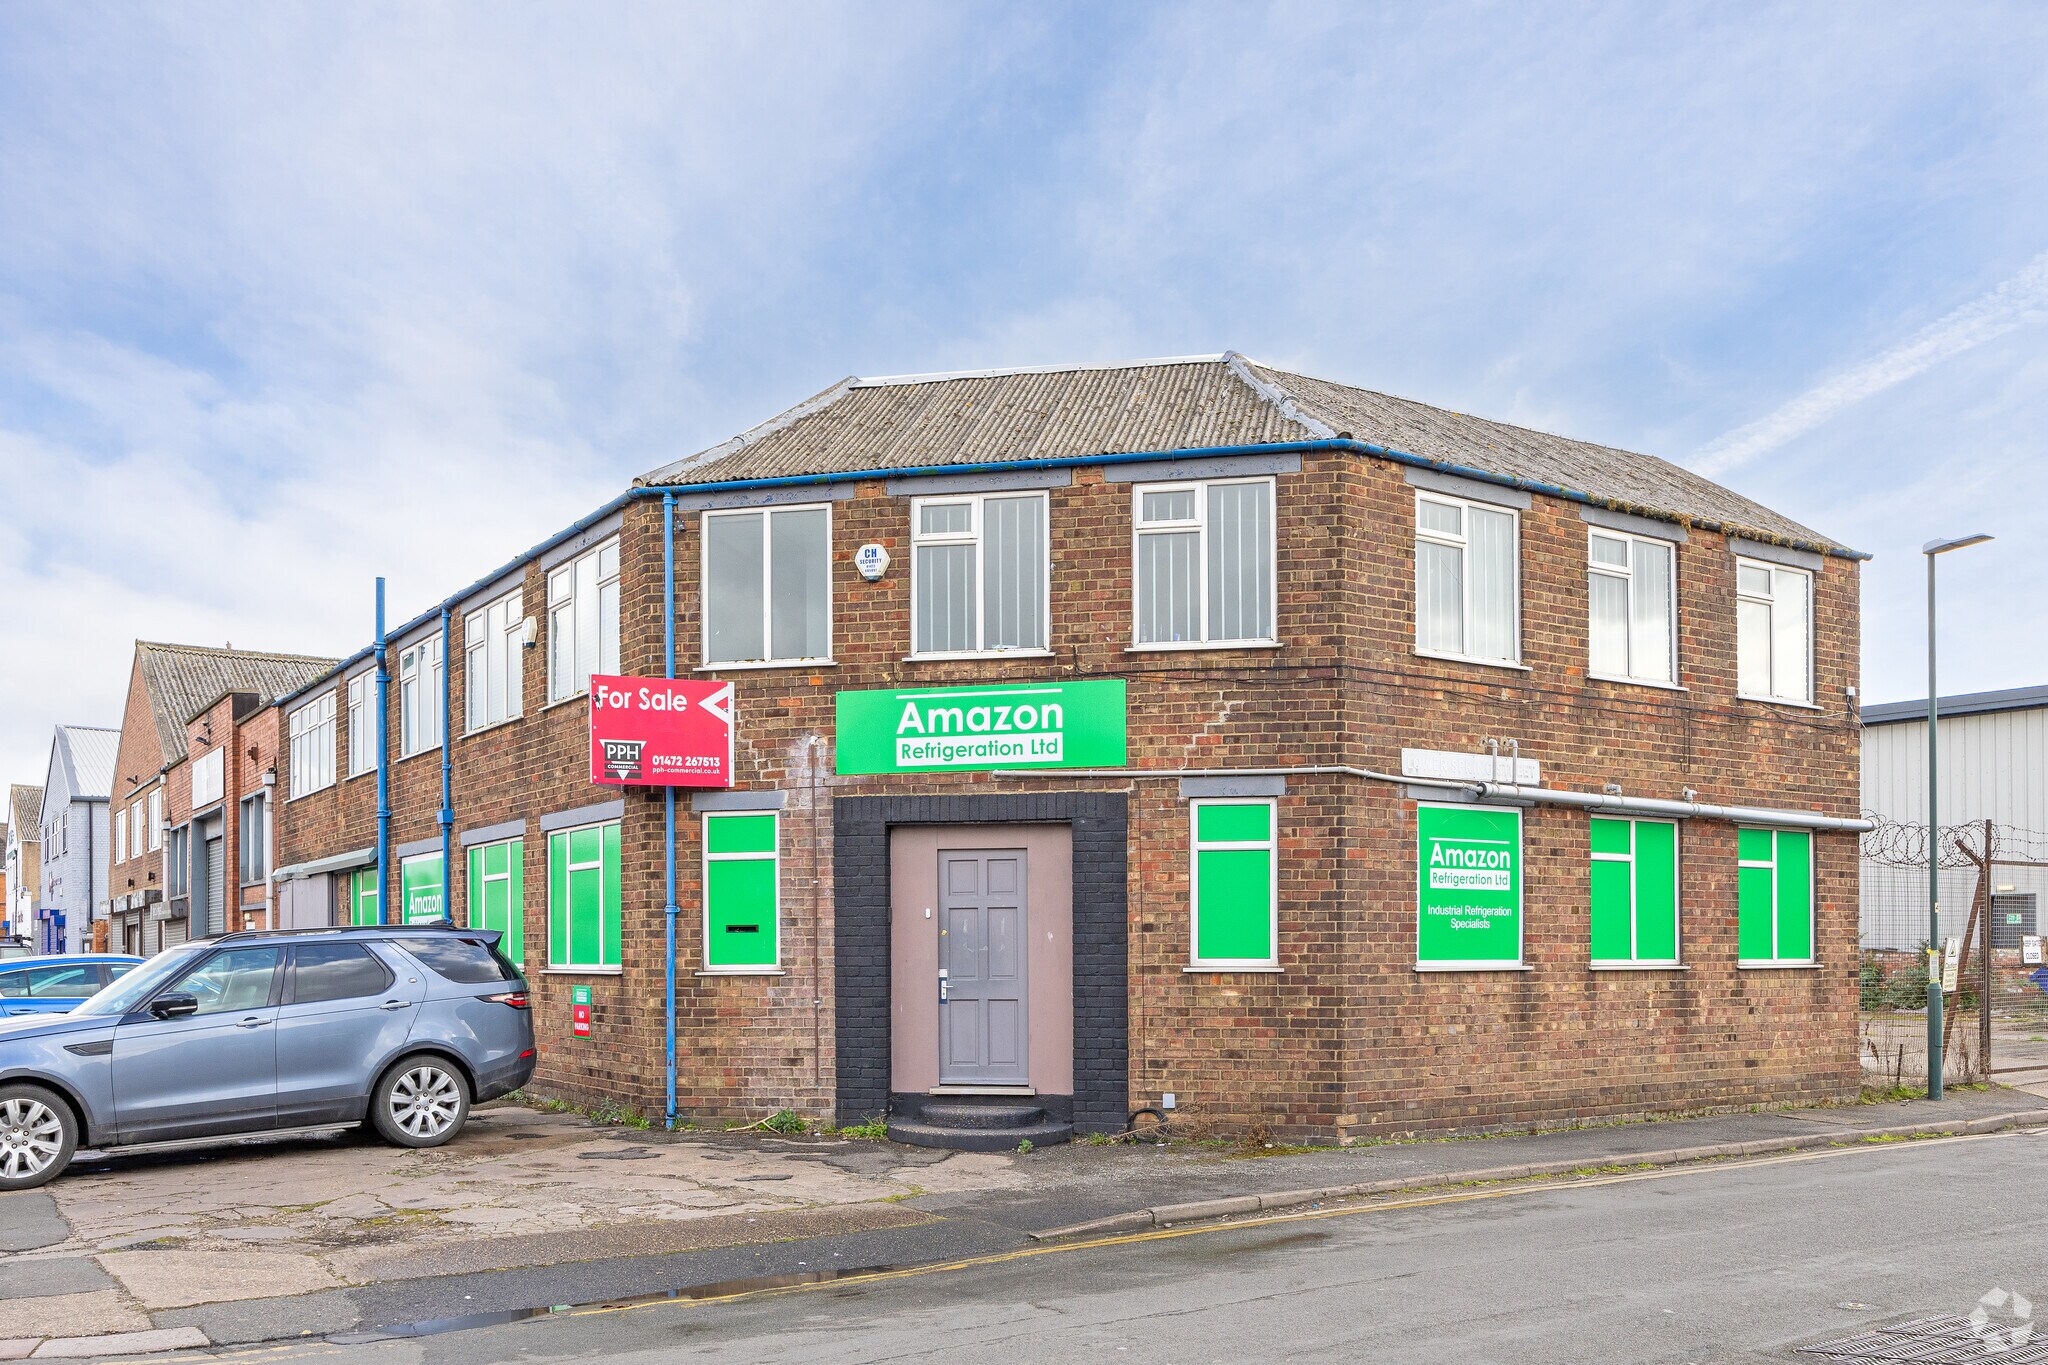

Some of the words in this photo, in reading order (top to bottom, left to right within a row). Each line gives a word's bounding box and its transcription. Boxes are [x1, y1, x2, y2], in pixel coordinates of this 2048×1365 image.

[864, 548, 877, 558] CH
[597, 685, 632, 709] For
[638, 687, 688, 712] Sale
[896, 702, 1063, 735] Amazon
[606, 744, 639, 760] PPH
[901, 740, 1023, 762] Refrigeration
[1031, 738, 1058, 755] Ltd
[652, 755, 683, 766] 01472
[685, 756, 720, 767] 267513
[1430, 842, 1511, 869] Amazon
[1432, 872, 1492, 887] Refrigeration
[1495, 874, 1508, 886] Ltd
[409, 892, 442, 914] Amazon
[1428, 904, 1463, 916] Industrial
[1465, 906, 1512, 918] Refrigeration
[1450, 918, 1491, 930] Specialists
[578, 1010, 585, 1019] NO
